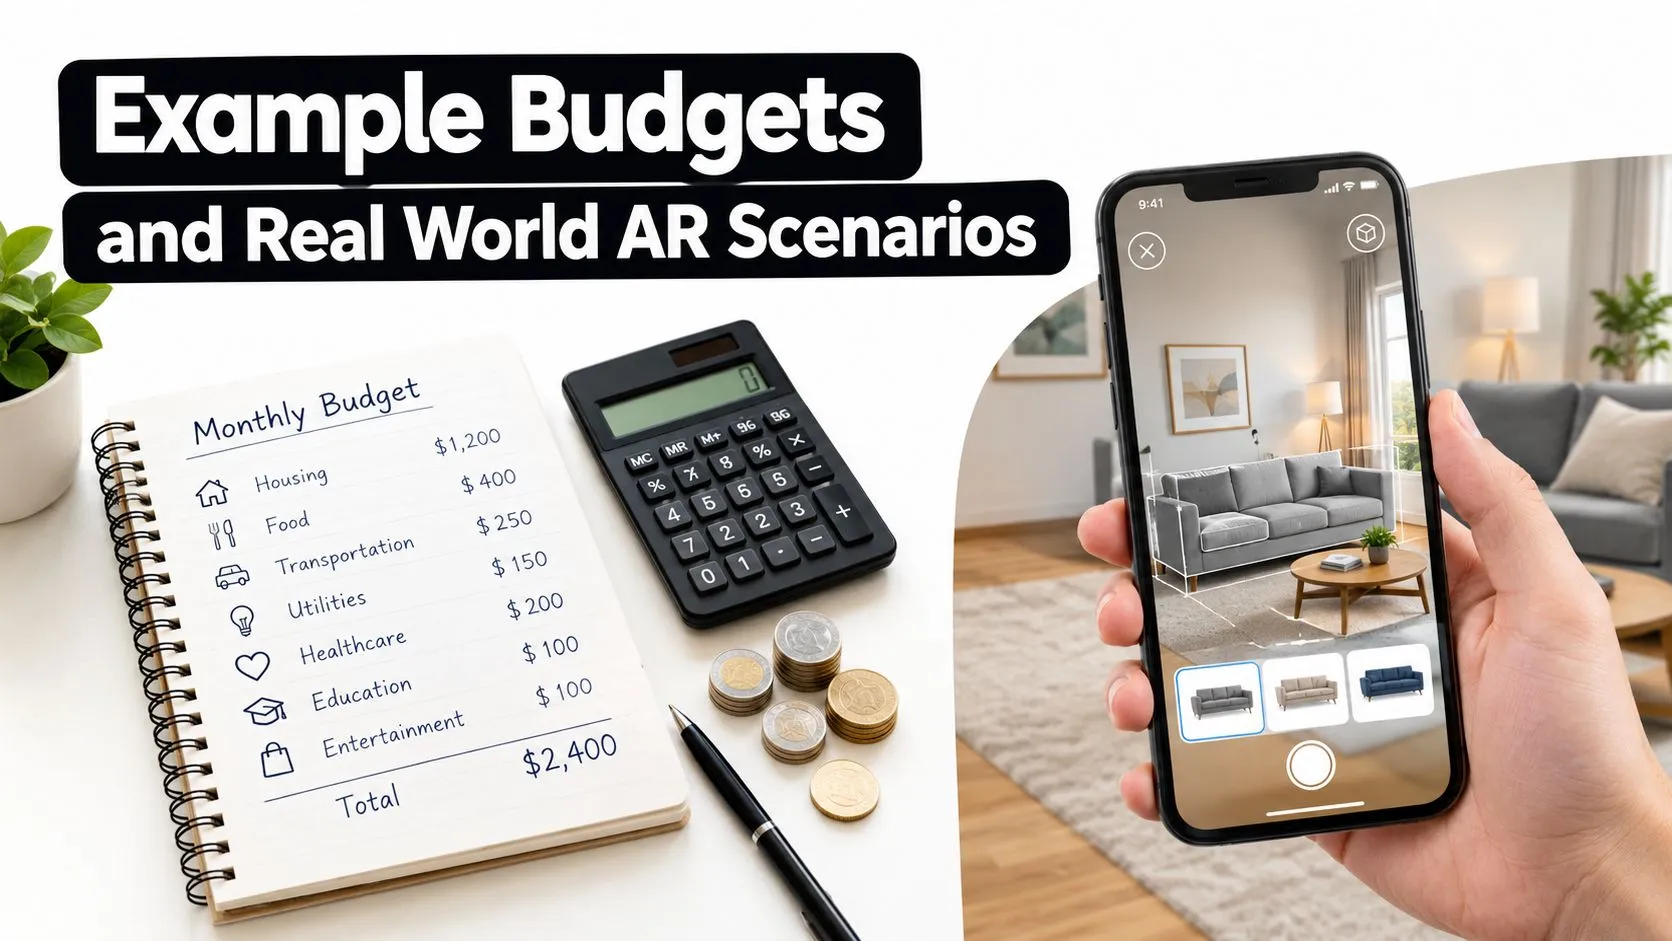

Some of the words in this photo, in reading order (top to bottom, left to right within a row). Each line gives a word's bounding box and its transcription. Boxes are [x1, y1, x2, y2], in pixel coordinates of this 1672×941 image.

[1138, 197, 1164, 210] 9:41
[193, 400, 305, 445] Monthly
[319, 378, 421, 417] Budget
[254, 468, 329, 493] Housing
[434, 428, 501, 457] $1,200
[630, 452, 653, 467] MC
[665, 441, 688, 456] MR
[265, 510, 310, 535] Food
[667, 506, 681, 522] 4
[683, 537, 695, 553] 7
[720, 526, 735, 541] 2
[754, 513, 771, 529] 2
[790, 501, 806, 517] 3
[275, 537, 415, 575] Transportation
[701, 568, 716, 584] 0
[736, 555, 750, 571] 1
[287, 591, 367, 619] Utilities
[299, 630, 407, 665] Healthcare
[311, 677, 413, 712] Education
[322, 710, 465, 759] Entertainment
[335, 783, 400, 818] Total
[523, 733, 617, 778] $2,400
